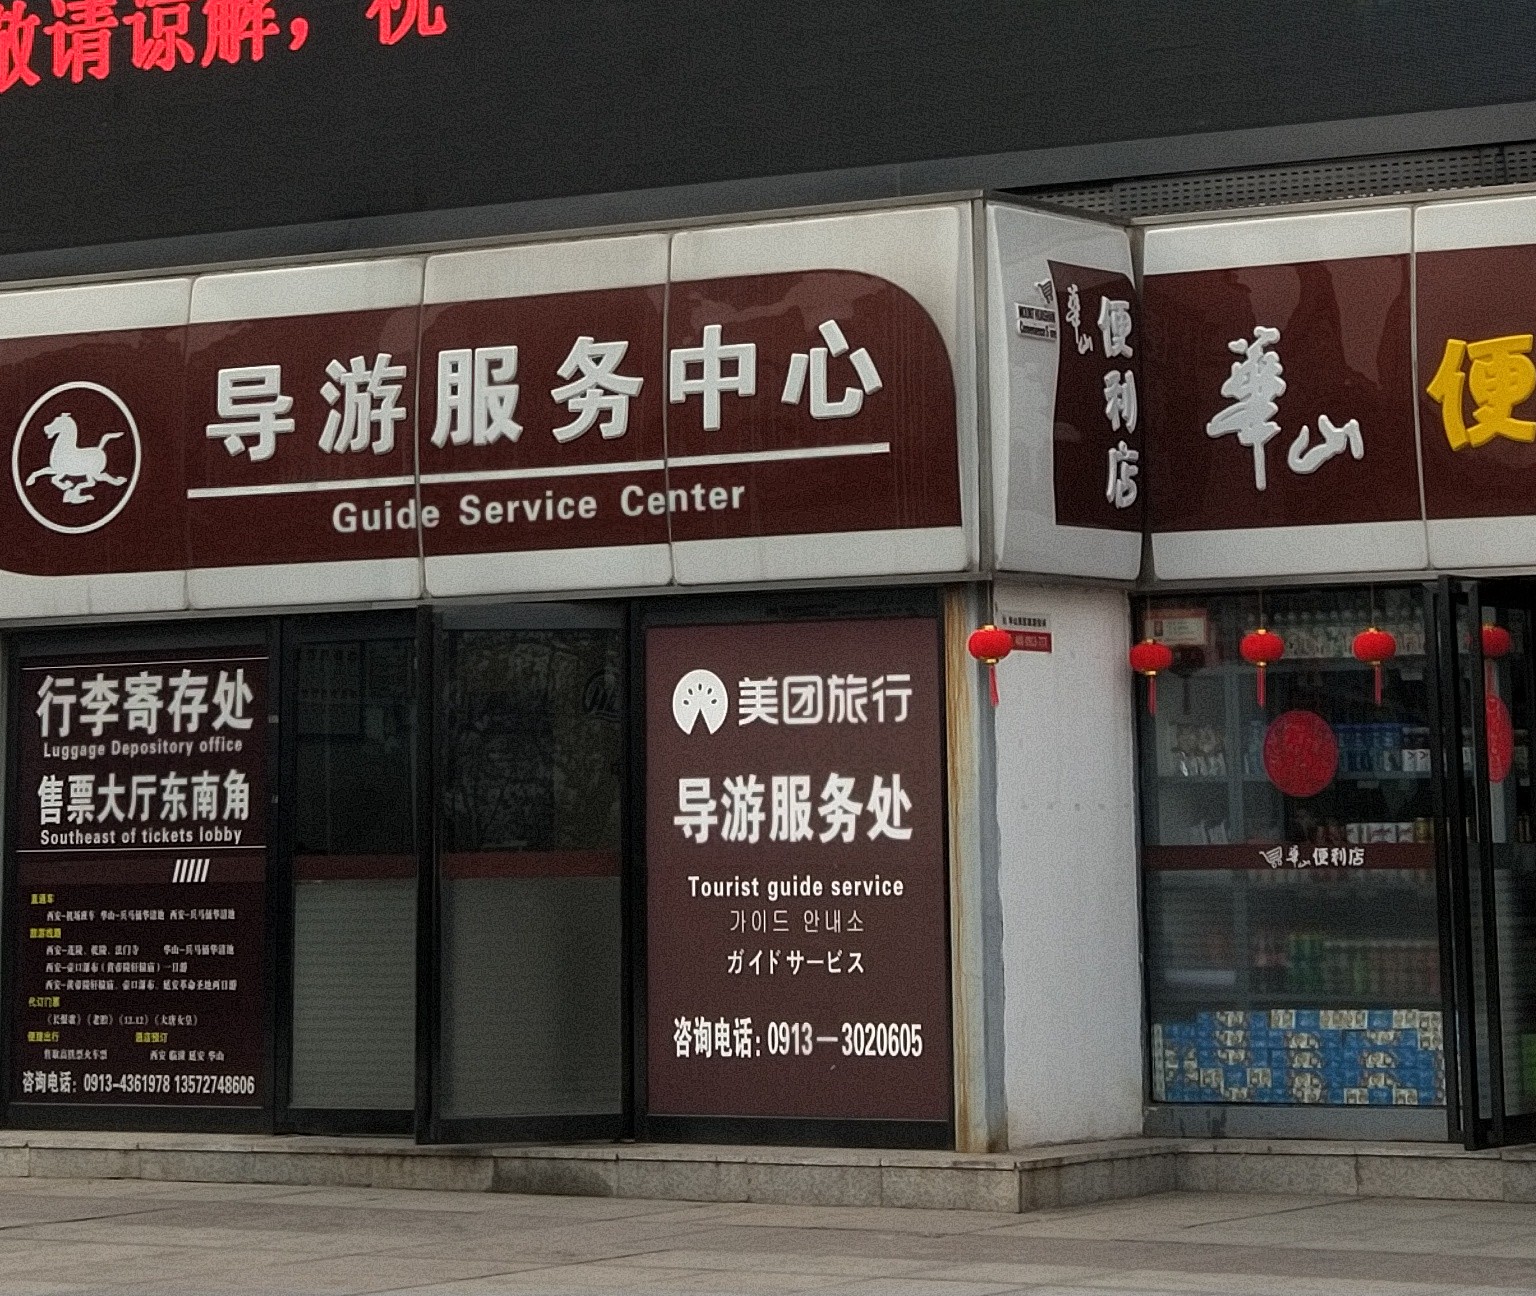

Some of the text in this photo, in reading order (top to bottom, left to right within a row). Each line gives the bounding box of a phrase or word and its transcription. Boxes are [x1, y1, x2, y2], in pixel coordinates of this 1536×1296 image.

[205, 318, 883, 462] 导游服务中心
[331, 478, 747, 535] Guide Service Center
[37, 668, 254, 738] 行李寄存处
[738, 673, 913, 727] 美团旅行
[43, 736, 243, 760] Luggage Depository office
[38, 769, 250, 825] 售票大厅东南角
[673, 772, 914, 844] 导游服务处
[40, 826, 243, 846] Southeast of tickets lobby
[687, 873, 905, 901] Tourist guide service
[729, 908, 866, 935] 가이드 안내소
[727, 948, 866, 976] ガイドサービス
